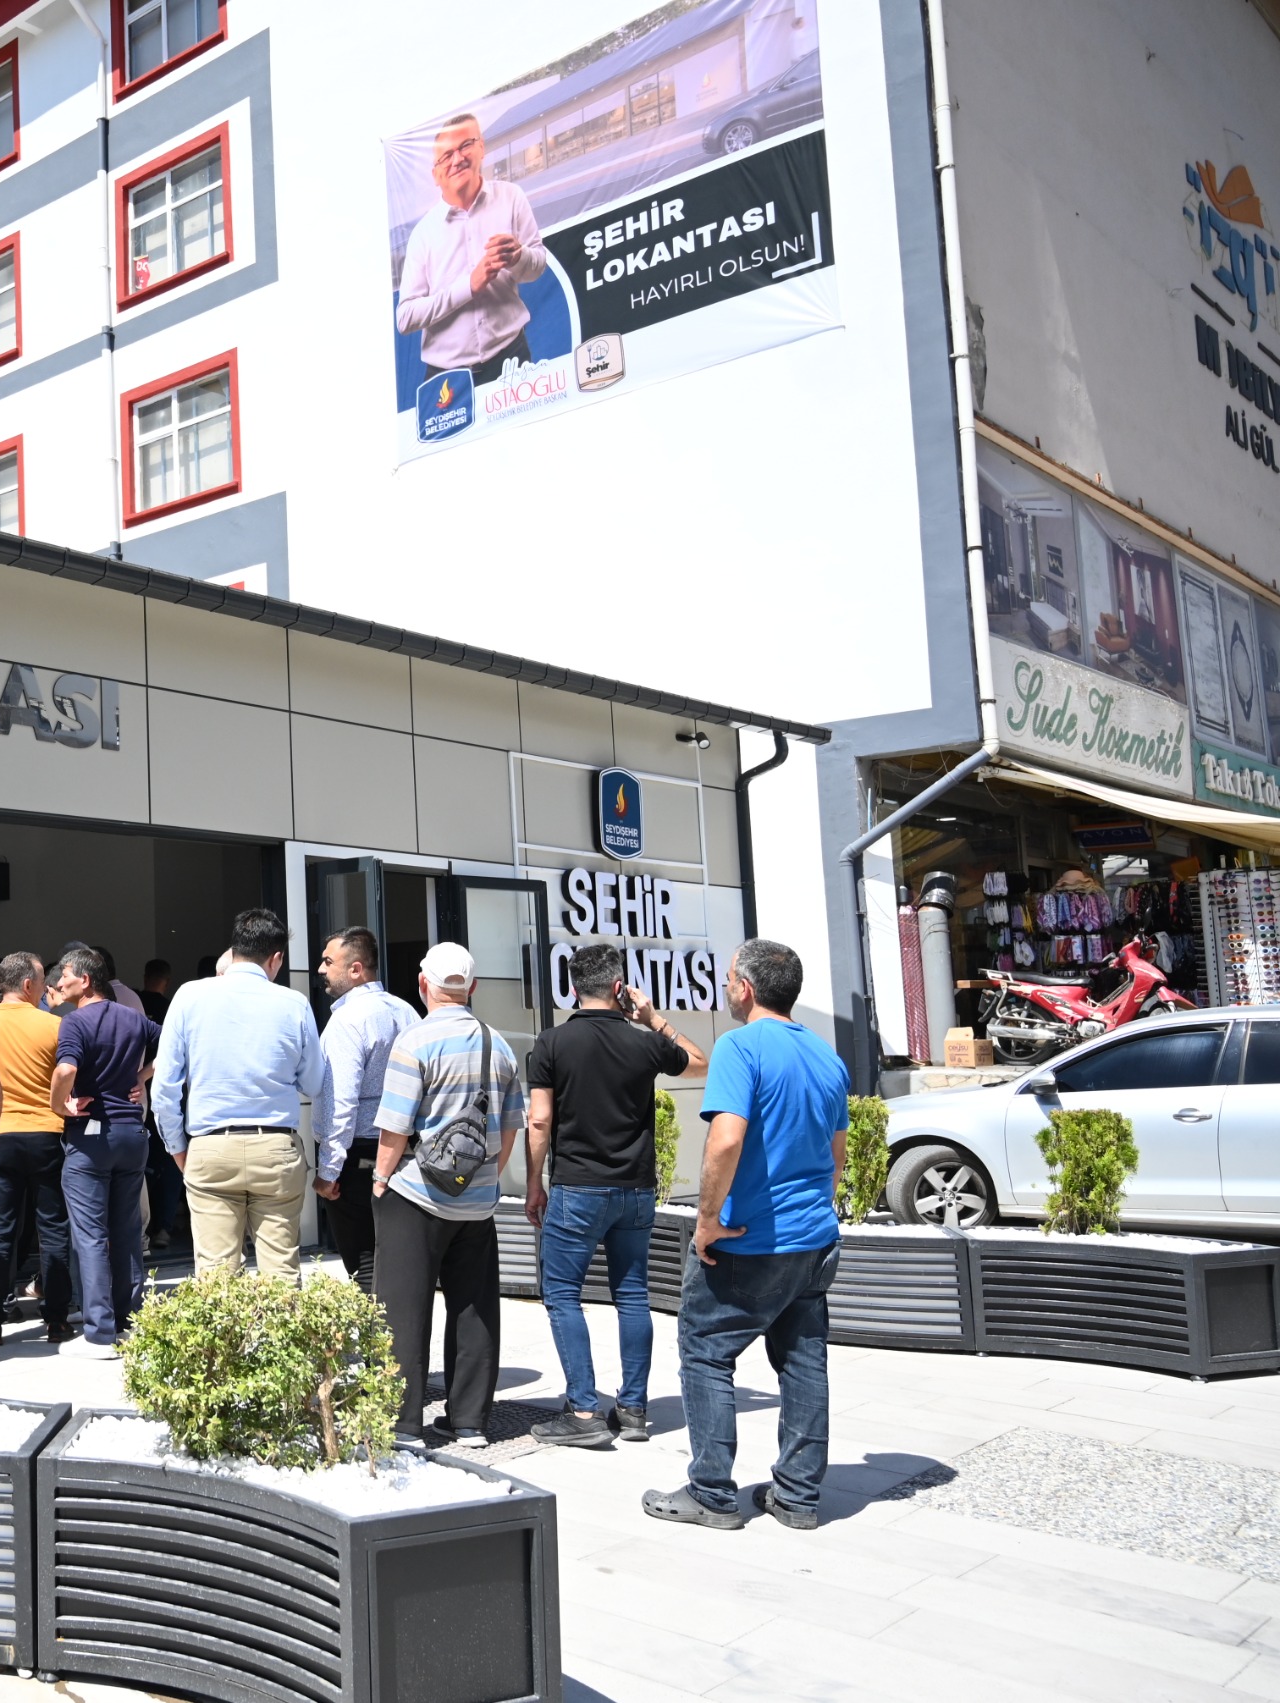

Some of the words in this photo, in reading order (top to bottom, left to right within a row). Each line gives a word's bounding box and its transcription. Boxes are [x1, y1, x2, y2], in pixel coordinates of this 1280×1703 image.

[583, 198, 685, 261] ŞEHİR
[586, 201, 776, 291] LOKANTASI
[630, 266, 713, 309] HAYIRLI
[719, 234, 805, 277] OLSUN!
[485, 368, 567, 414] USTAOĞLU
[586, 361, 610, 378] Şehir
[1225, 404, 1249, 451] ALİ
[1249, 423, 1280, 473] GÜL
[1006, 660, 1078, 746] Sude
[1083, 828, 1142, 839] AVON
